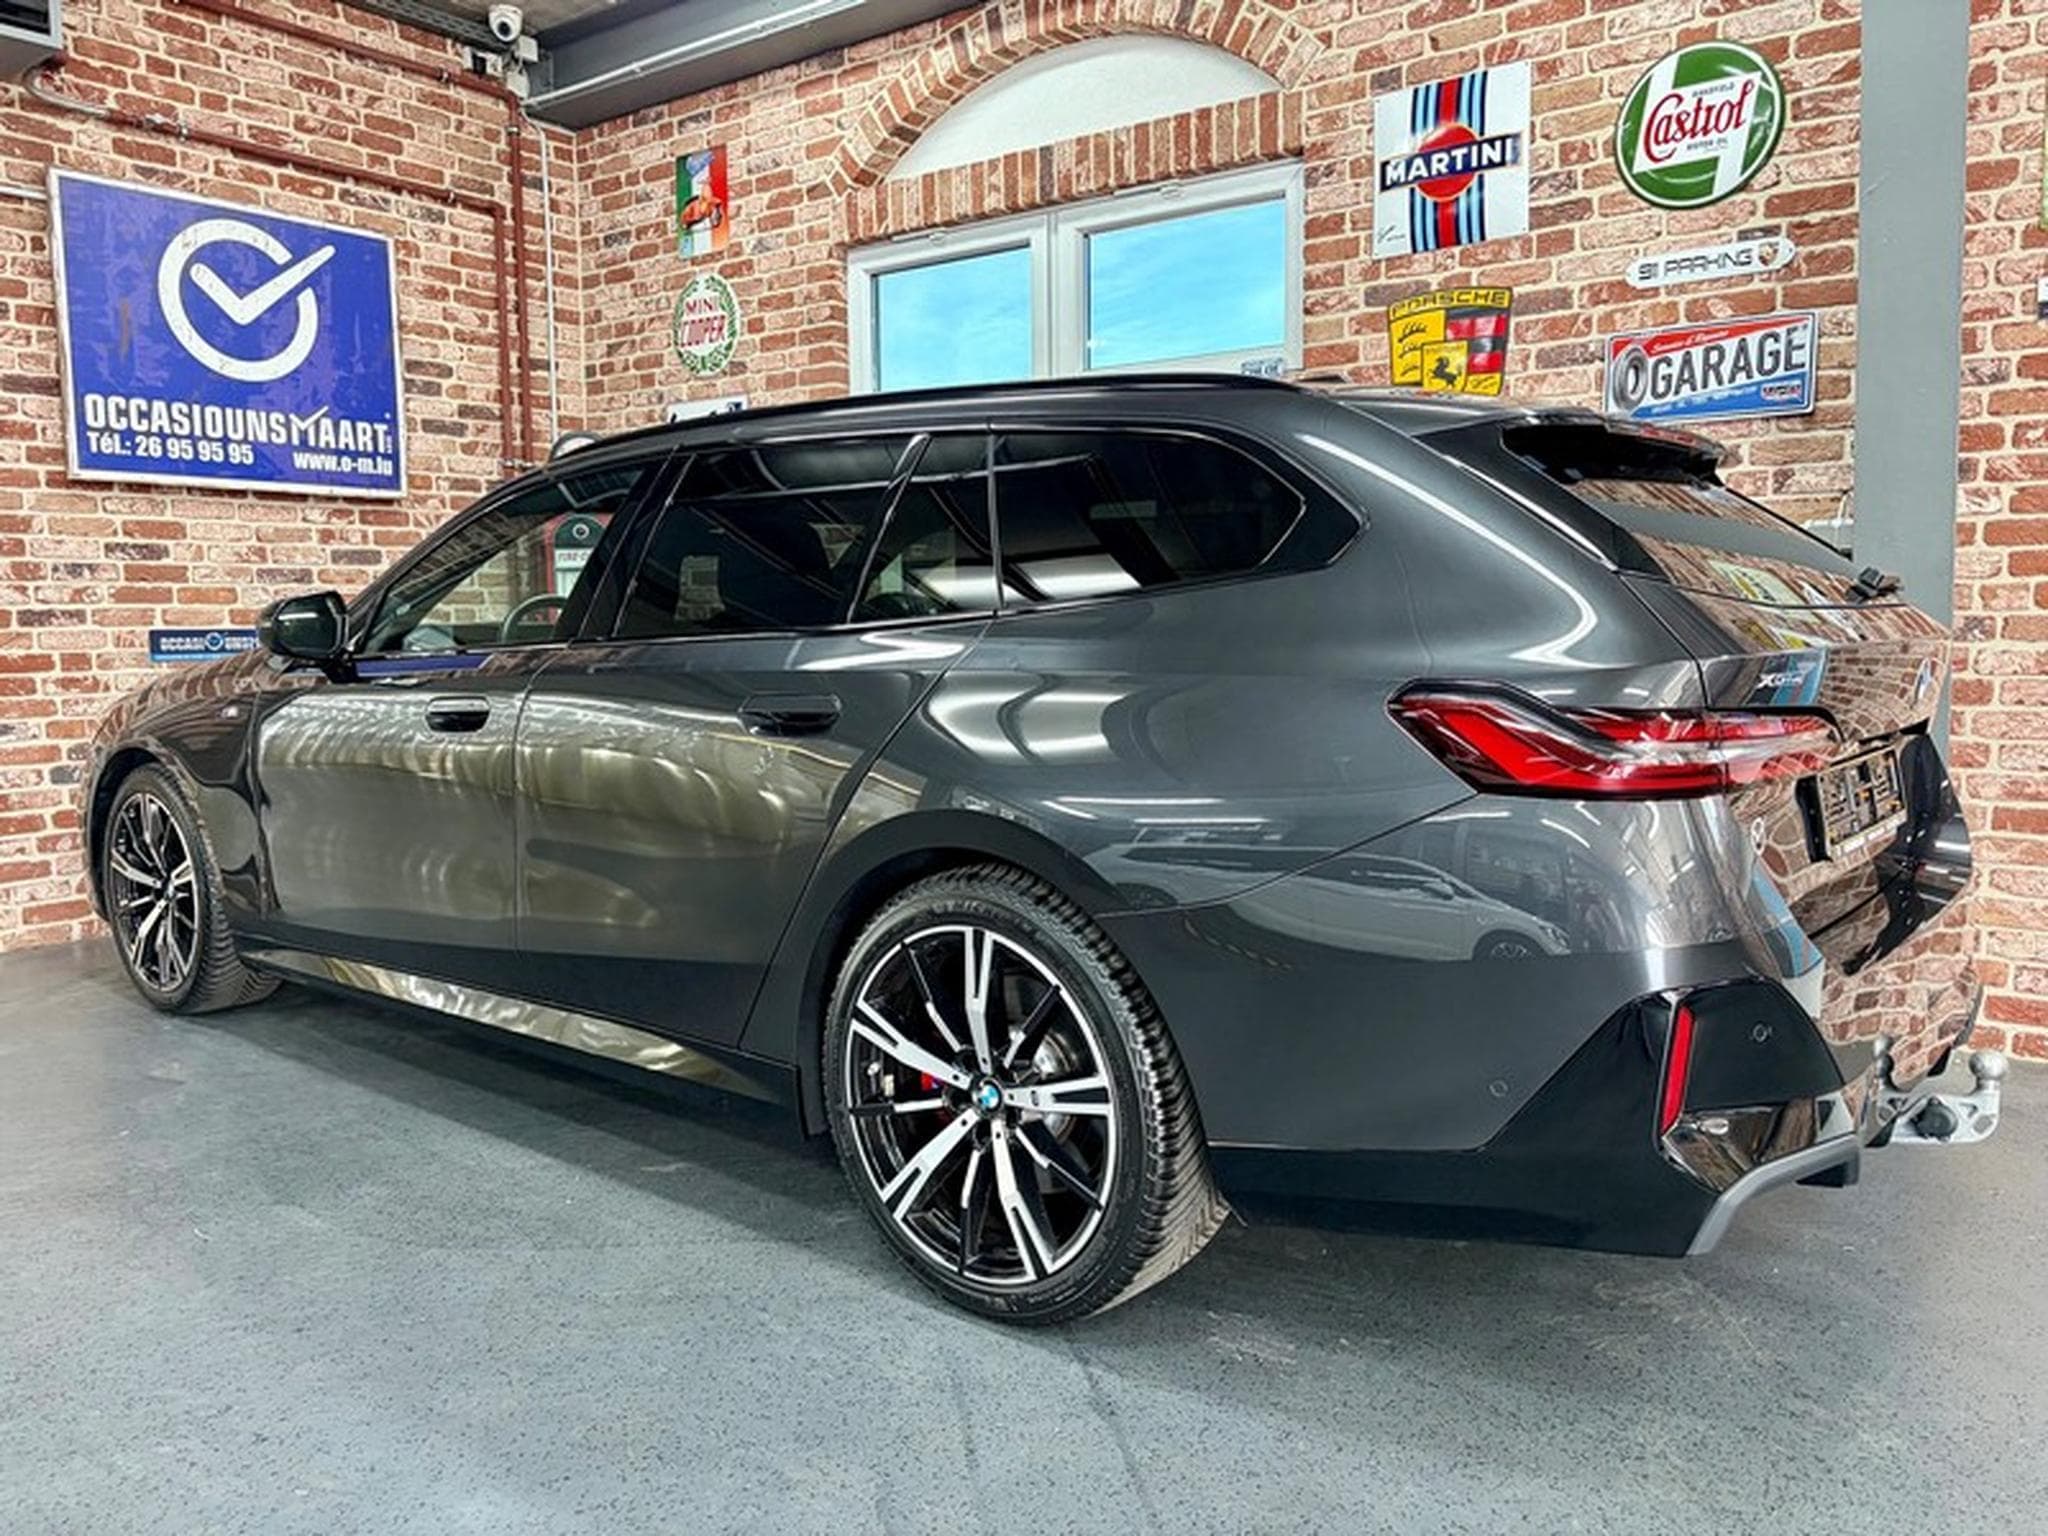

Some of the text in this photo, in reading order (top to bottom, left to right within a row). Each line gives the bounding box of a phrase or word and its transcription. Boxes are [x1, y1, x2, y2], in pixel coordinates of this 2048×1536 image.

[1643, 79, 1755, 164] Castrol
[1385, 138, 1513, 187] MARTINI
[1663, 248, 1753, 277] PARKING
[1391, 290, 1507, 319] PORSCHE
[680, 315, 726, 348] COOPER
[1650, 323, 1808, 401] GARAGE
[135, 434, 160, 458] 26
[166, 437, 193, 460] 95
[198, 440, 225, 463] 95
[229, 443, 255, 465] 95
[293, 451, 393, 476] www.o-m.lu
